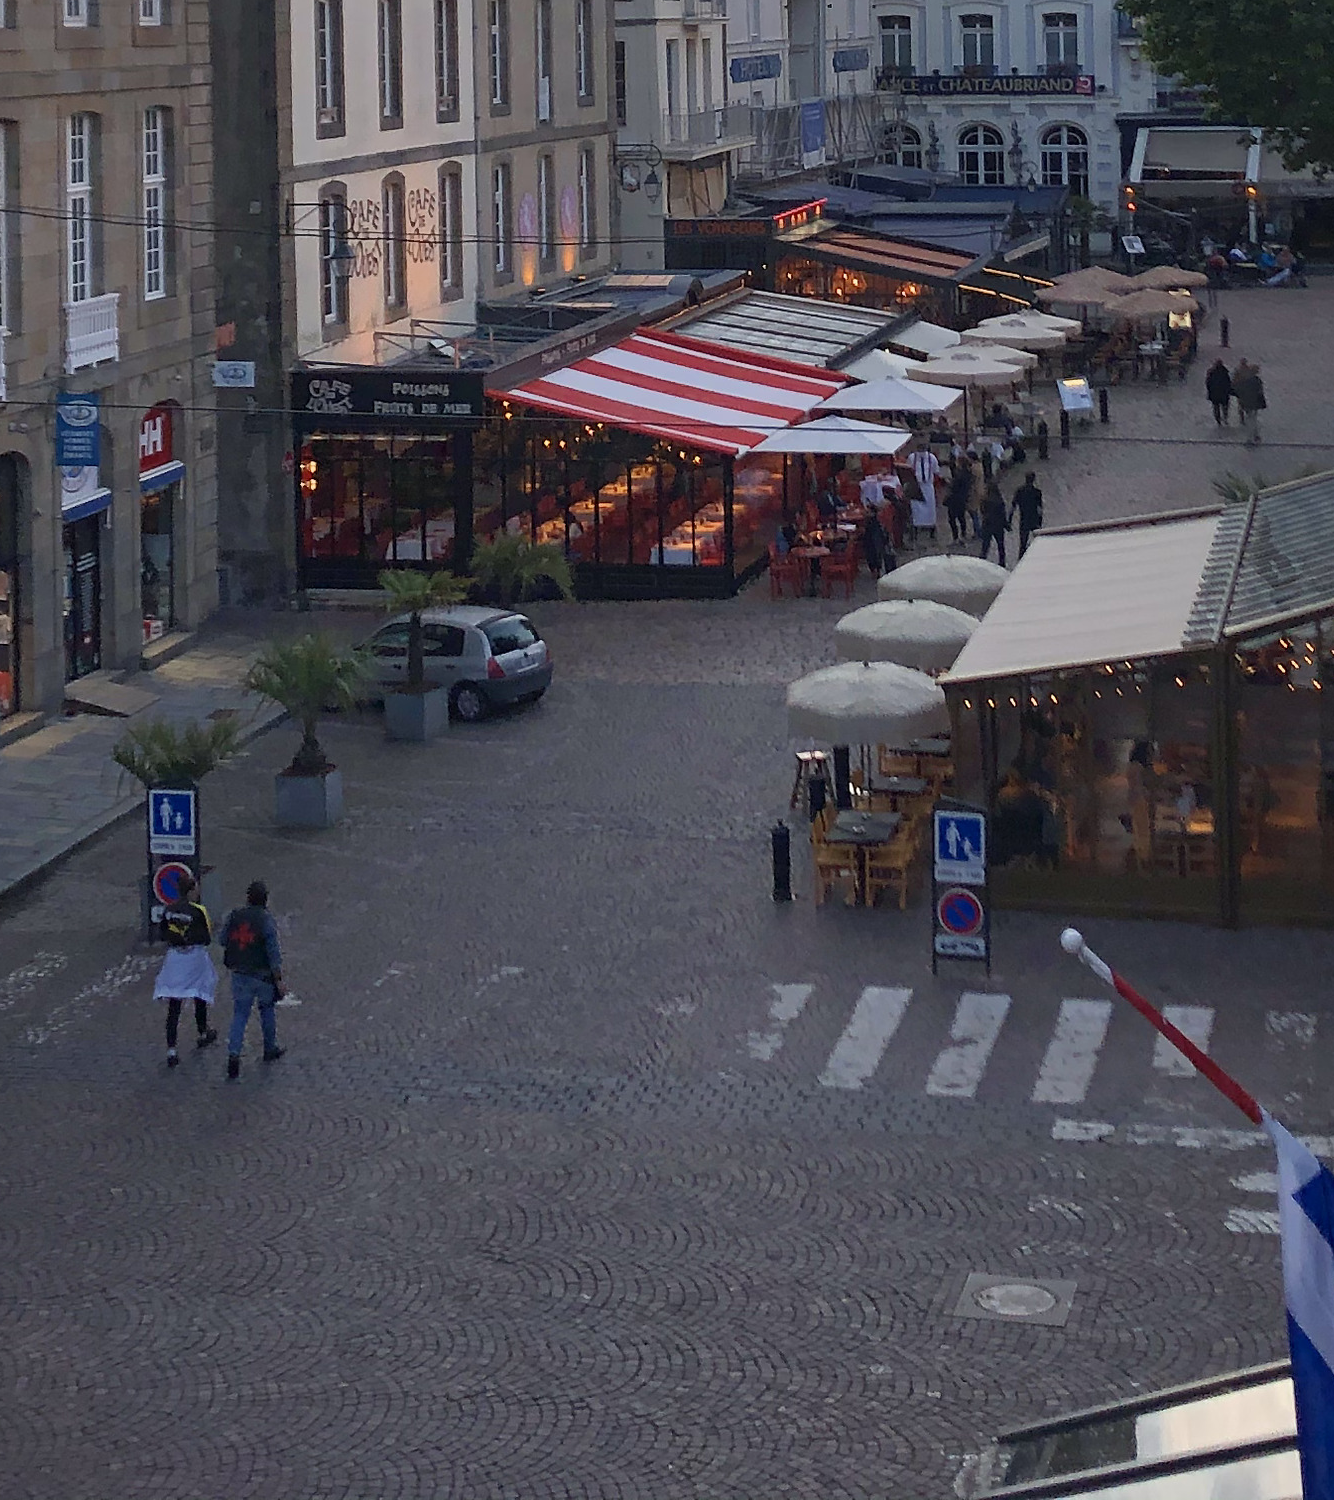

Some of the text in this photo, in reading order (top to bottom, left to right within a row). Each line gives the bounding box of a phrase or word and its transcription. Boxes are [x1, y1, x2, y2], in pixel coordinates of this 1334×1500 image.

[938, 77, 1075, 92] CHATEAUBRIAND
[392, 382, 450, 397] POISSONS
[373, 401, 472, 416] FRUITS DE MER
[139, 416, 163, 460] HH
